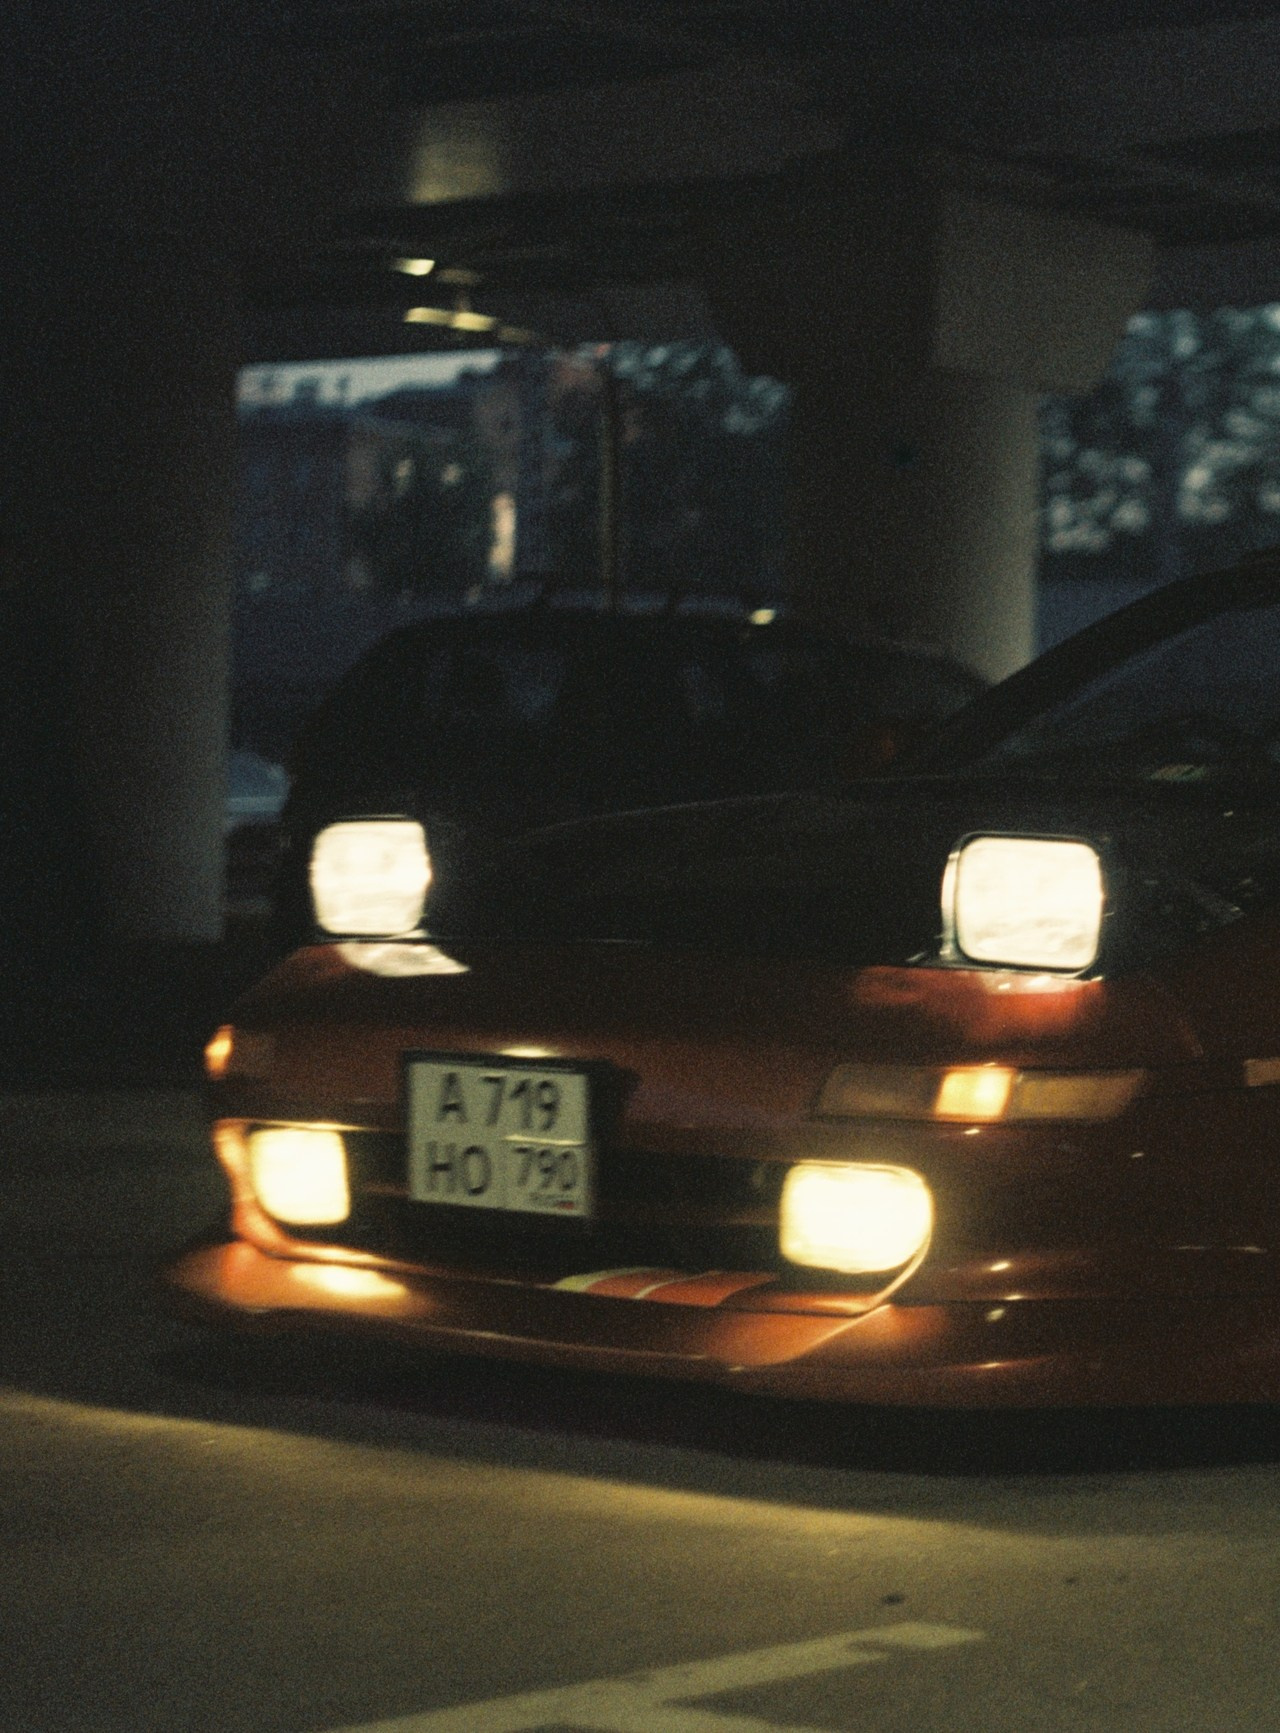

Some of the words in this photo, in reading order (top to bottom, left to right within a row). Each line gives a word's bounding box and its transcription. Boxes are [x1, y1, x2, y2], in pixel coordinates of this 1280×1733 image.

[436, 1072, 468, 1124] A
[480, 1075, 561, 1131] 719
[425, 1141, 492, 1197] HO
[512, 1147, 579, 1191] 790
